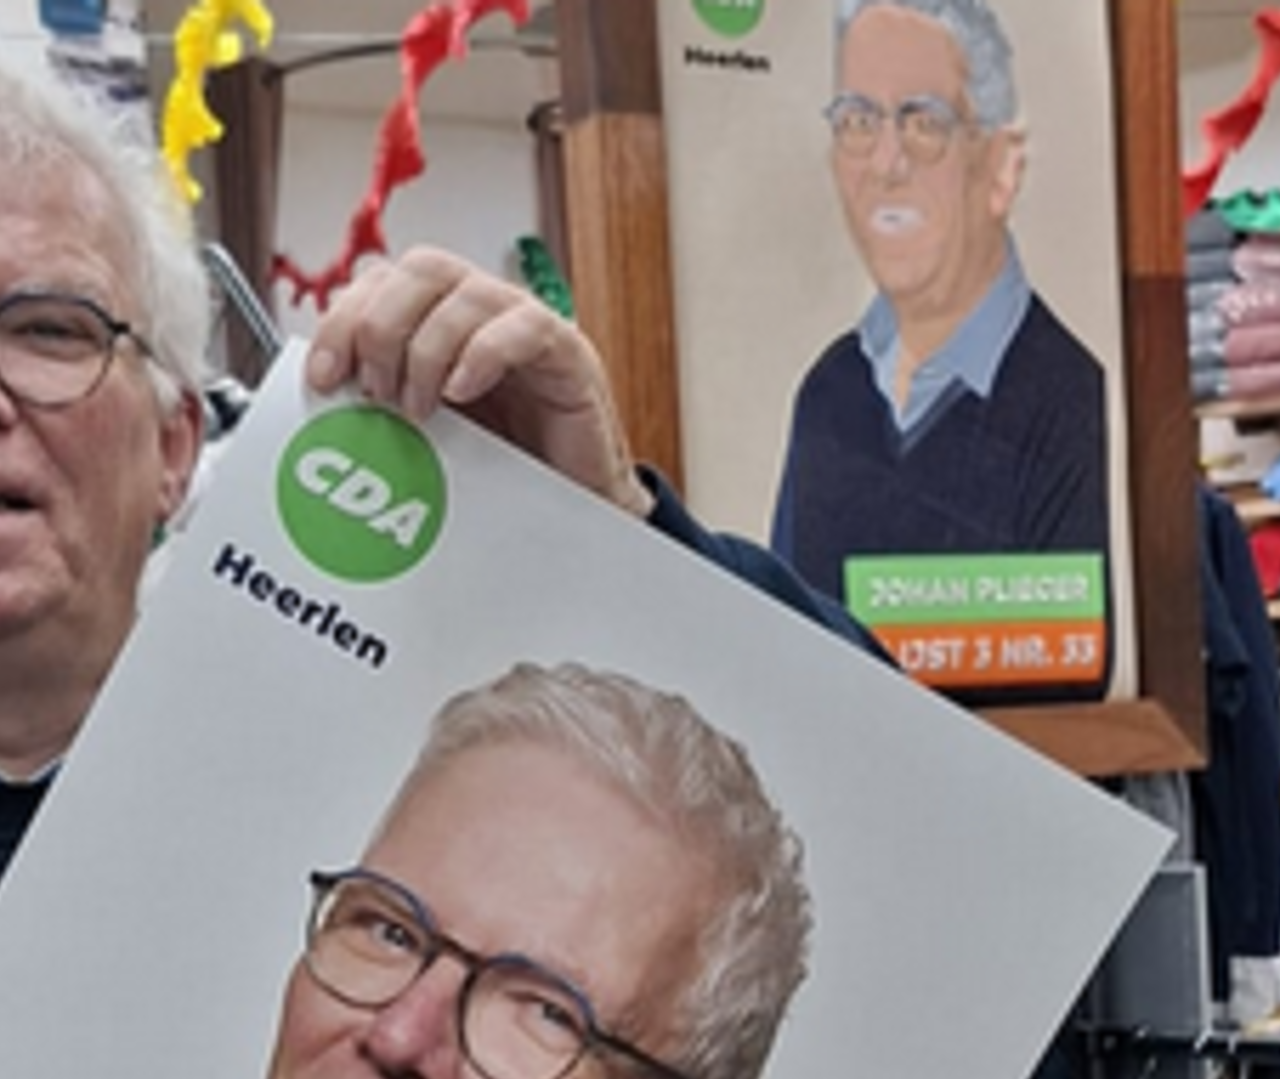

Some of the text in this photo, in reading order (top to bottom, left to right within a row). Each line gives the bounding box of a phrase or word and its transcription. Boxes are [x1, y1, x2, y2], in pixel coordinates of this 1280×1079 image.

[293, 447, 431, 549] CDA
[213, 543, 390, 669] Heerlen
[870, 571, 1090, 606] JOHAN PLIEGER
[898, 633, 1097, 671] IJST 3 NR. 33
